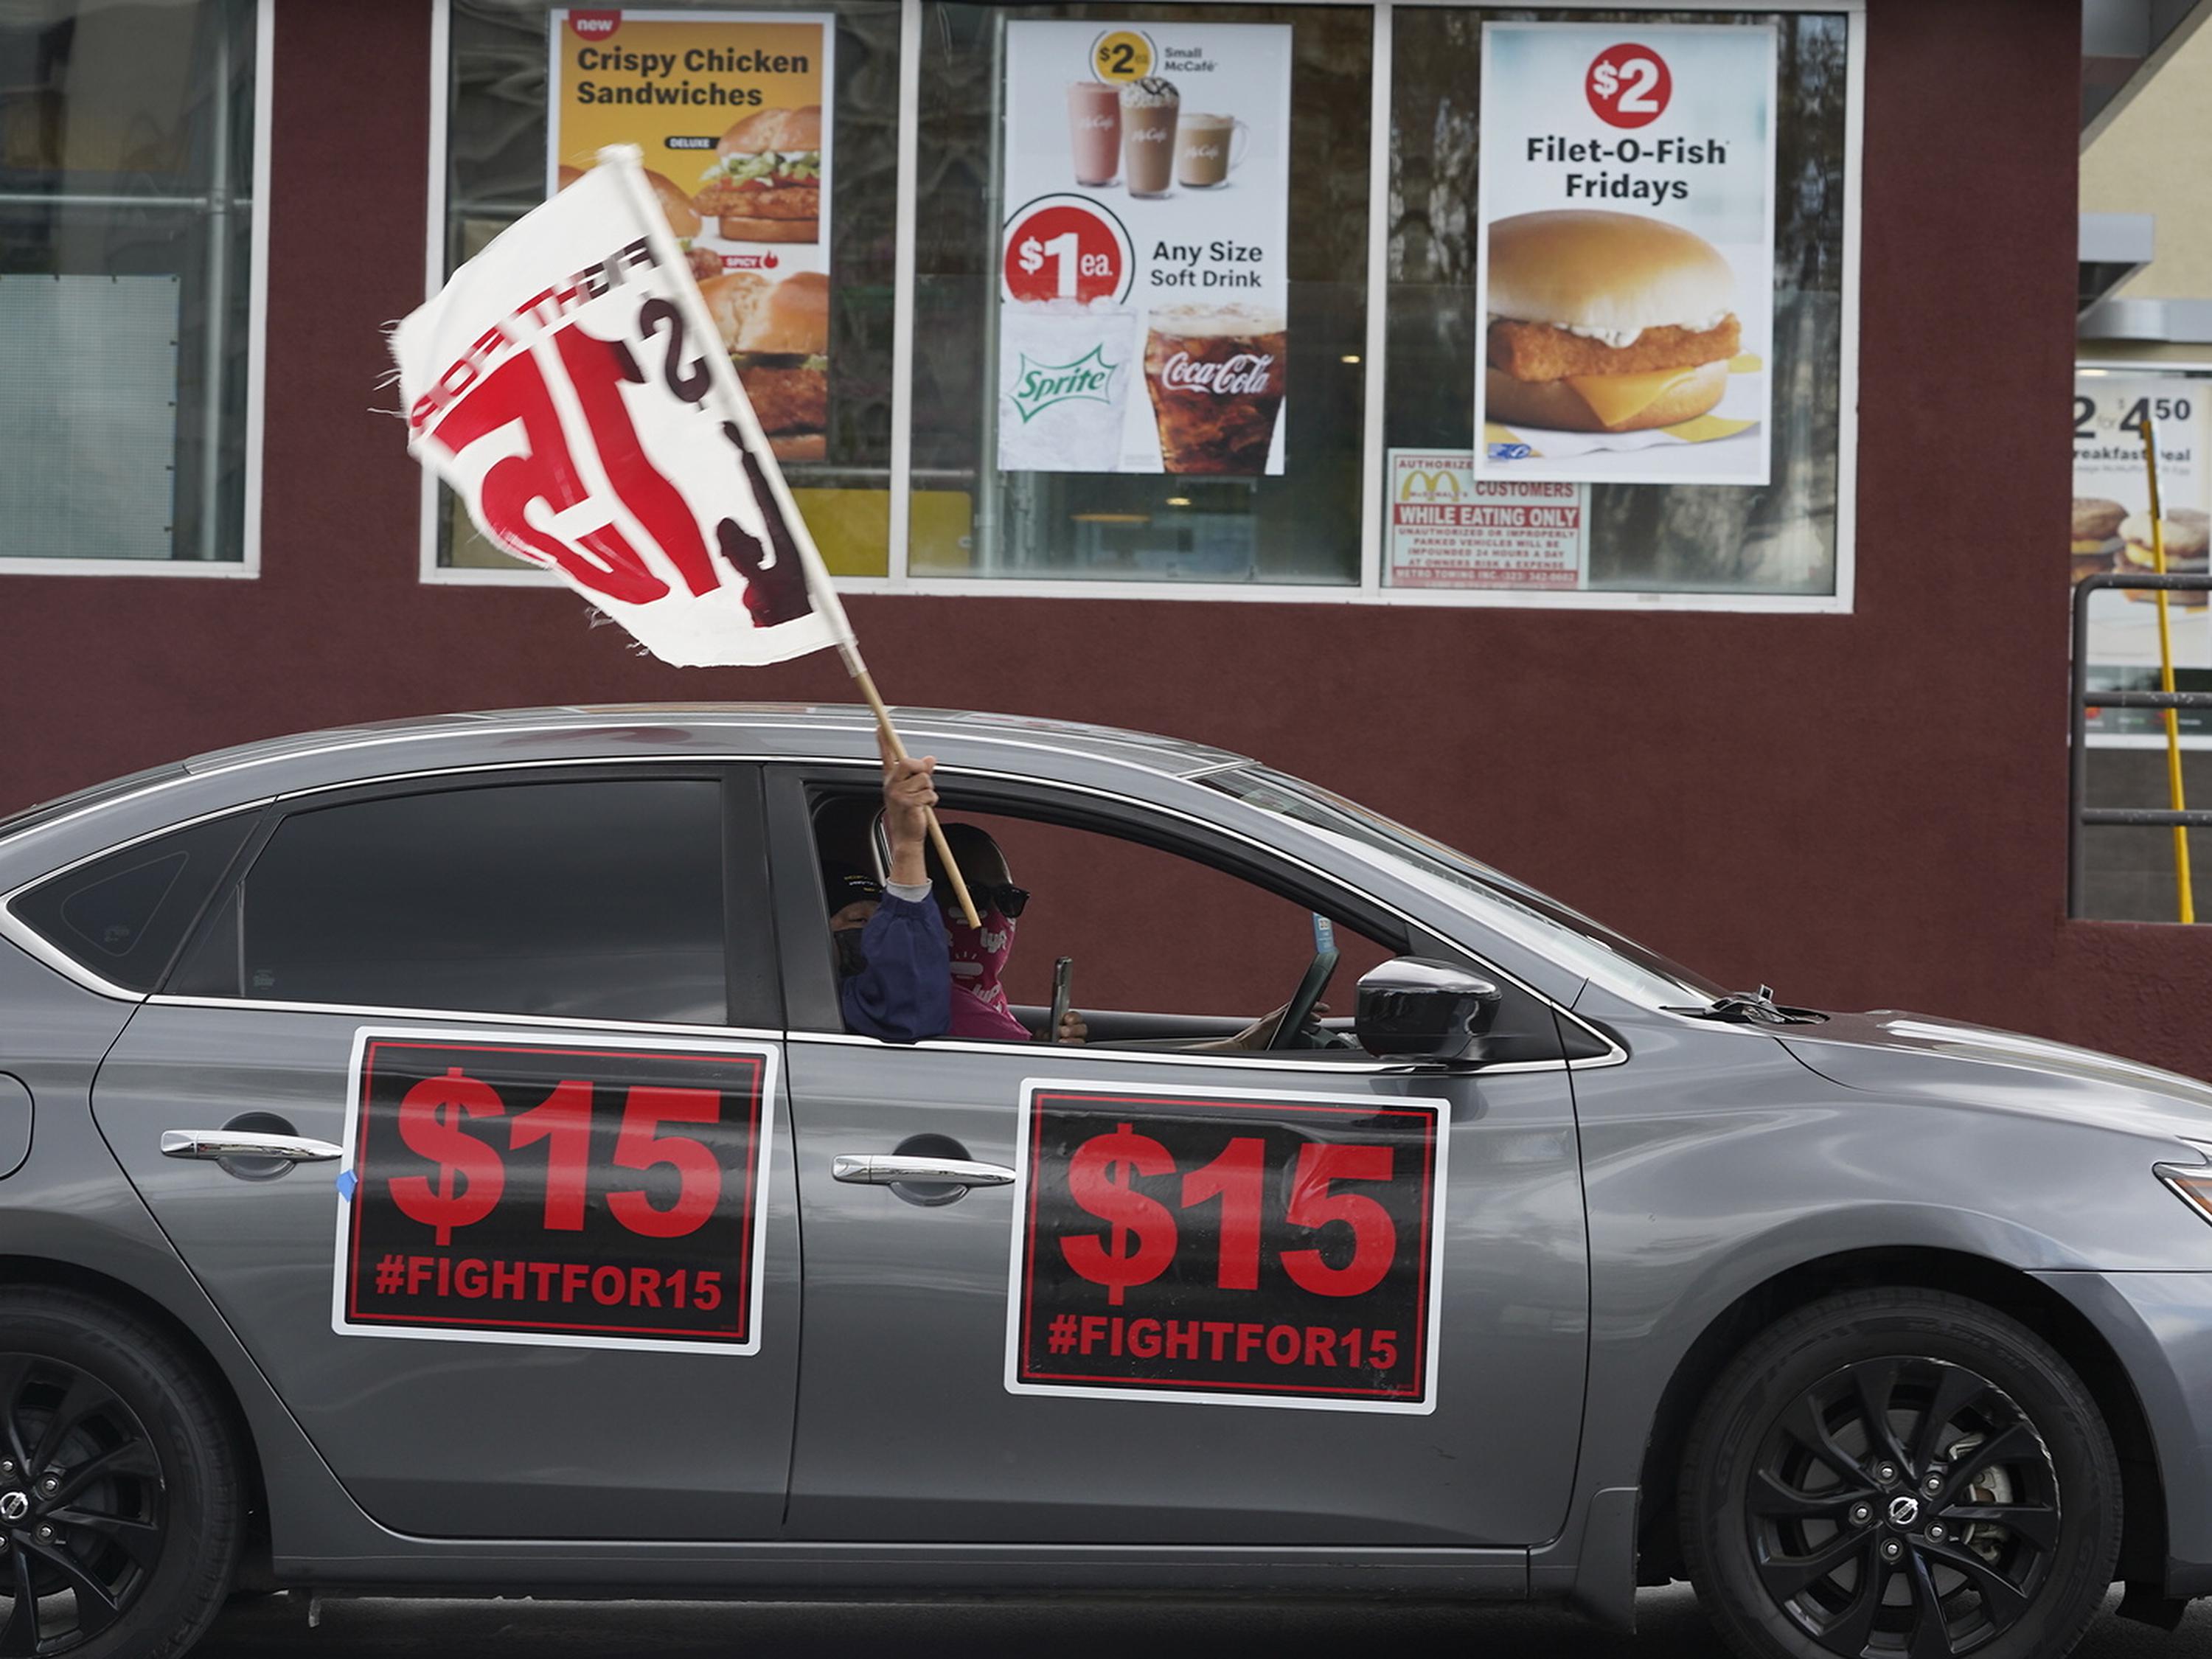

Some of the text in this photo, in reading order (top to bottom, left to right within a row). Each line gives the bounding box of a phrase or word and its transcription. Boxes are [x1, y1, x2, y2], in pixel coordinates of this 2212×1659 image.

[577, 18, 613, 32] new
[577, 46, 809, 77] Crispy Chicken
[1099, 43, 1135, 74] $2
[1164, 47, 1203, 59] Small
[1164, 59, 1215, 72] McCafé
[577, 80, 763, 106] Sandwiches
[1592, 58, 1659, 114] $2
[669, 138, 710, 147] DELUXE
[1526, 135, 1727, 164] Filet-O-Fish
[1565, 171, 1688, 206] Fridays
[726, 256, 757, 268] SPICY
[1152, 240, 1263, 266] Any Size
[1151, 269, 1262, 288] Soft Drink
[1018, 366, 1107, 403] Sprite
[1161, 351, 1275, 394] Coca-Cola
[2073, 395, 2097, 439] 2
[1398, 460, 1473, 470] AUTHORIZE
[2073, 447, 2191, 461] reakfast eal
[1475, 481, 1574, 498] CUSTOMERS
[1400, 506, 1577, 528] WHILE EATING ONLY
[1399, 528, 1575, 539] UNAUTHORIZED OR IMPROPERLY
[1414, 538, 1456, 546] PARKED
[1460, 539, 1512, 548] VEHICLES
[1546, 540, 1559, 549] BE
[1408, 548, 1472, 557] IMPOUNDED
[1492, 550, 1529, 558] HOURS
[1425, 559, 1470, 568] OWNERS
[1474, 560, 1500, 568] RISK
[1516, 561, 1565, 570] EXPENSE
[387, 1067, 722, 1246] $15
[1059, 1122, 1397, 1307] $15
[376, 1254, 722, 1311] #FIGHTFOR15
[1048, 1313, 1398, 1369] #FIGHTFOR15
